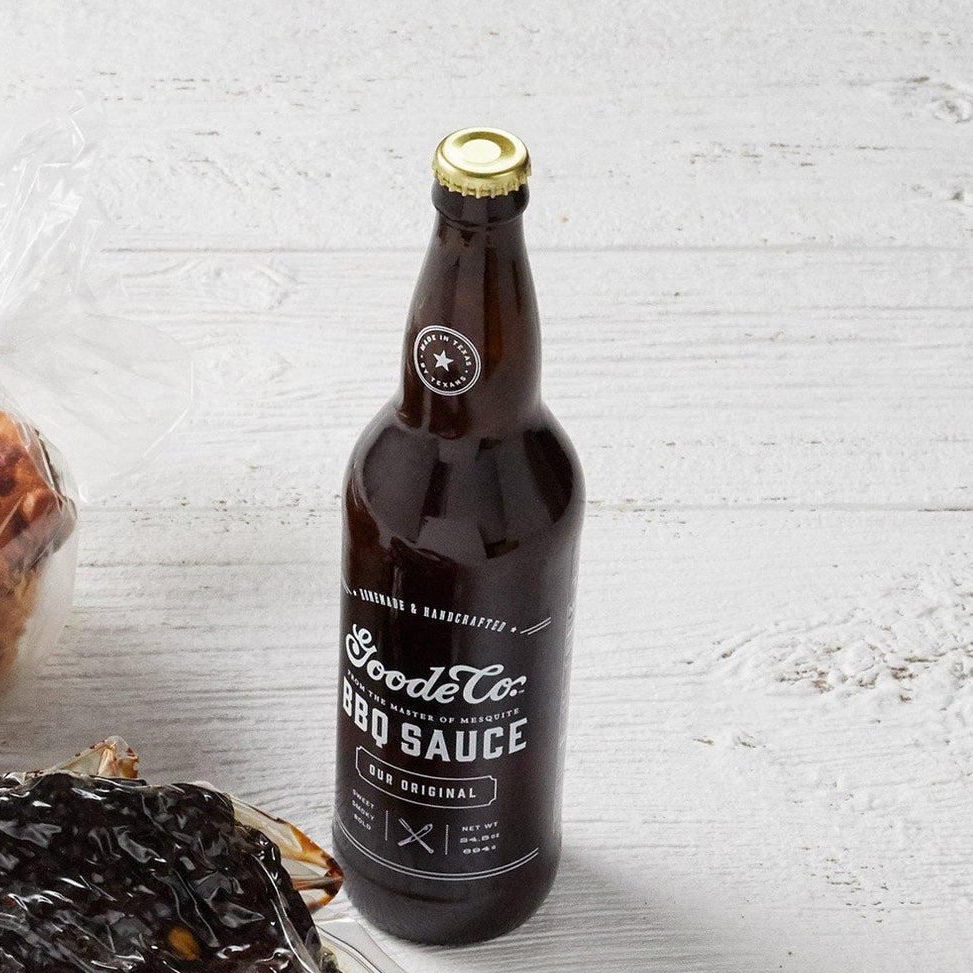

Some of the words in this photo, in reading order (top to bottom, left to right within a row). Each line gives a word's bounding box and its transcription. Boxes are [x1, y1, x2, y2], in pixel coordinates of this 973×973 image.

[420, 335, 436, 351] MADE
[453, 340, 471, 366] TEXAS
[420, 363, 429, 374] BY
[431, 376, 466, 388] TEXANS
[411, 603, 417, 614] &
[423, 606, 507, 633] HANDCRAFTED
[348, 669, 365, 692] FROM
[368, 690, 386, 706] THE
[390, 703, 434, 722] MASTER
[439, 716, 455, 724] OF
[460, 708, 520, 724] MESQUITE
[343, 676, 388, 748] BBQ
[401, 717, 527, 762] SAUCE
[369, 764, 393, 786] OUR
[401, 781, 477, 799] ORIGINAL
[352, 789, 374, 809] SWEET
[352, 800, 374, 820] SMOKY
[354, 813, 371, 830] BOLD
[484, 821, 498, 829] WT
